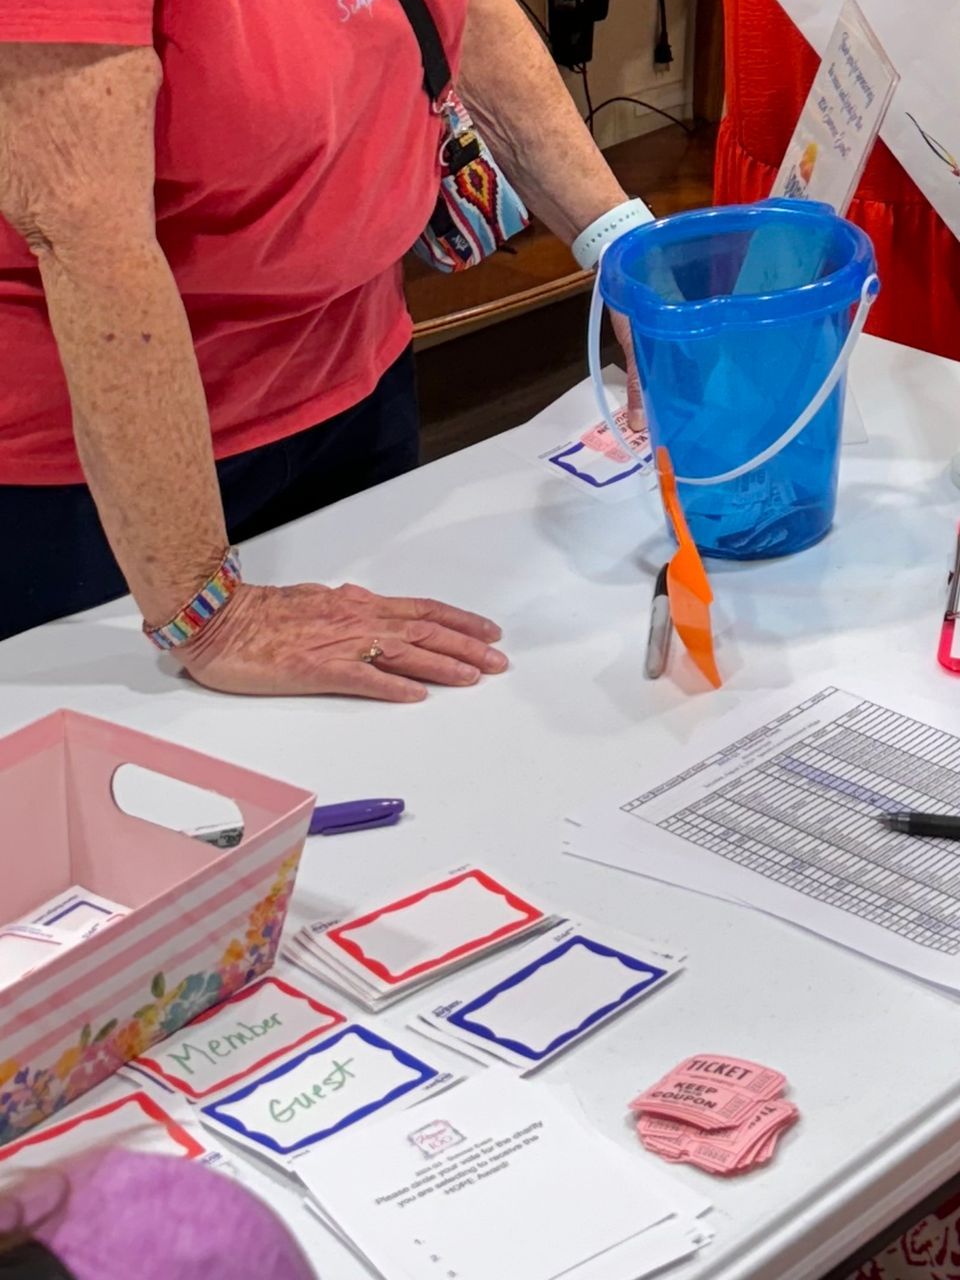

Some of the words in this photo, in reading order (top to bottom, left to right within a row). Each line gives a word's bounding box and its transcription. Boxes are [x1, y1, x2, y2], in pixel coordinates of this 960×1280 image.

[167, 1012, 283, 1075] Member
[269, 1057, 356, 1123] Guest
[674, 1082, 718, 1094] KEEP
[687, 1060, 752, 1080] TICKET
[651, 1091, 718, 1109] COUPON
[375, 1187, 410, 1205] Please
[411, 1174, 436, 1189] circle
[438, 1163, 458, 1177] your
[460, 1153, 481, 1165] vote
[481, 1145, 495, 1155] for
[496, 1137, 512, 1148] the
[513, 1120, 543, 1140] charity
[398, 1195, 417, 1208] you
[417, 1187, 434, 1198] are
[435, 1165, 478, 1189] selecting
[477, 1160, 488, 1169] to
[489, 1144, 523, 1162] receive
[523, 1134, 539, 1145] the
[444, 1178, 475, 1195] HOPE
